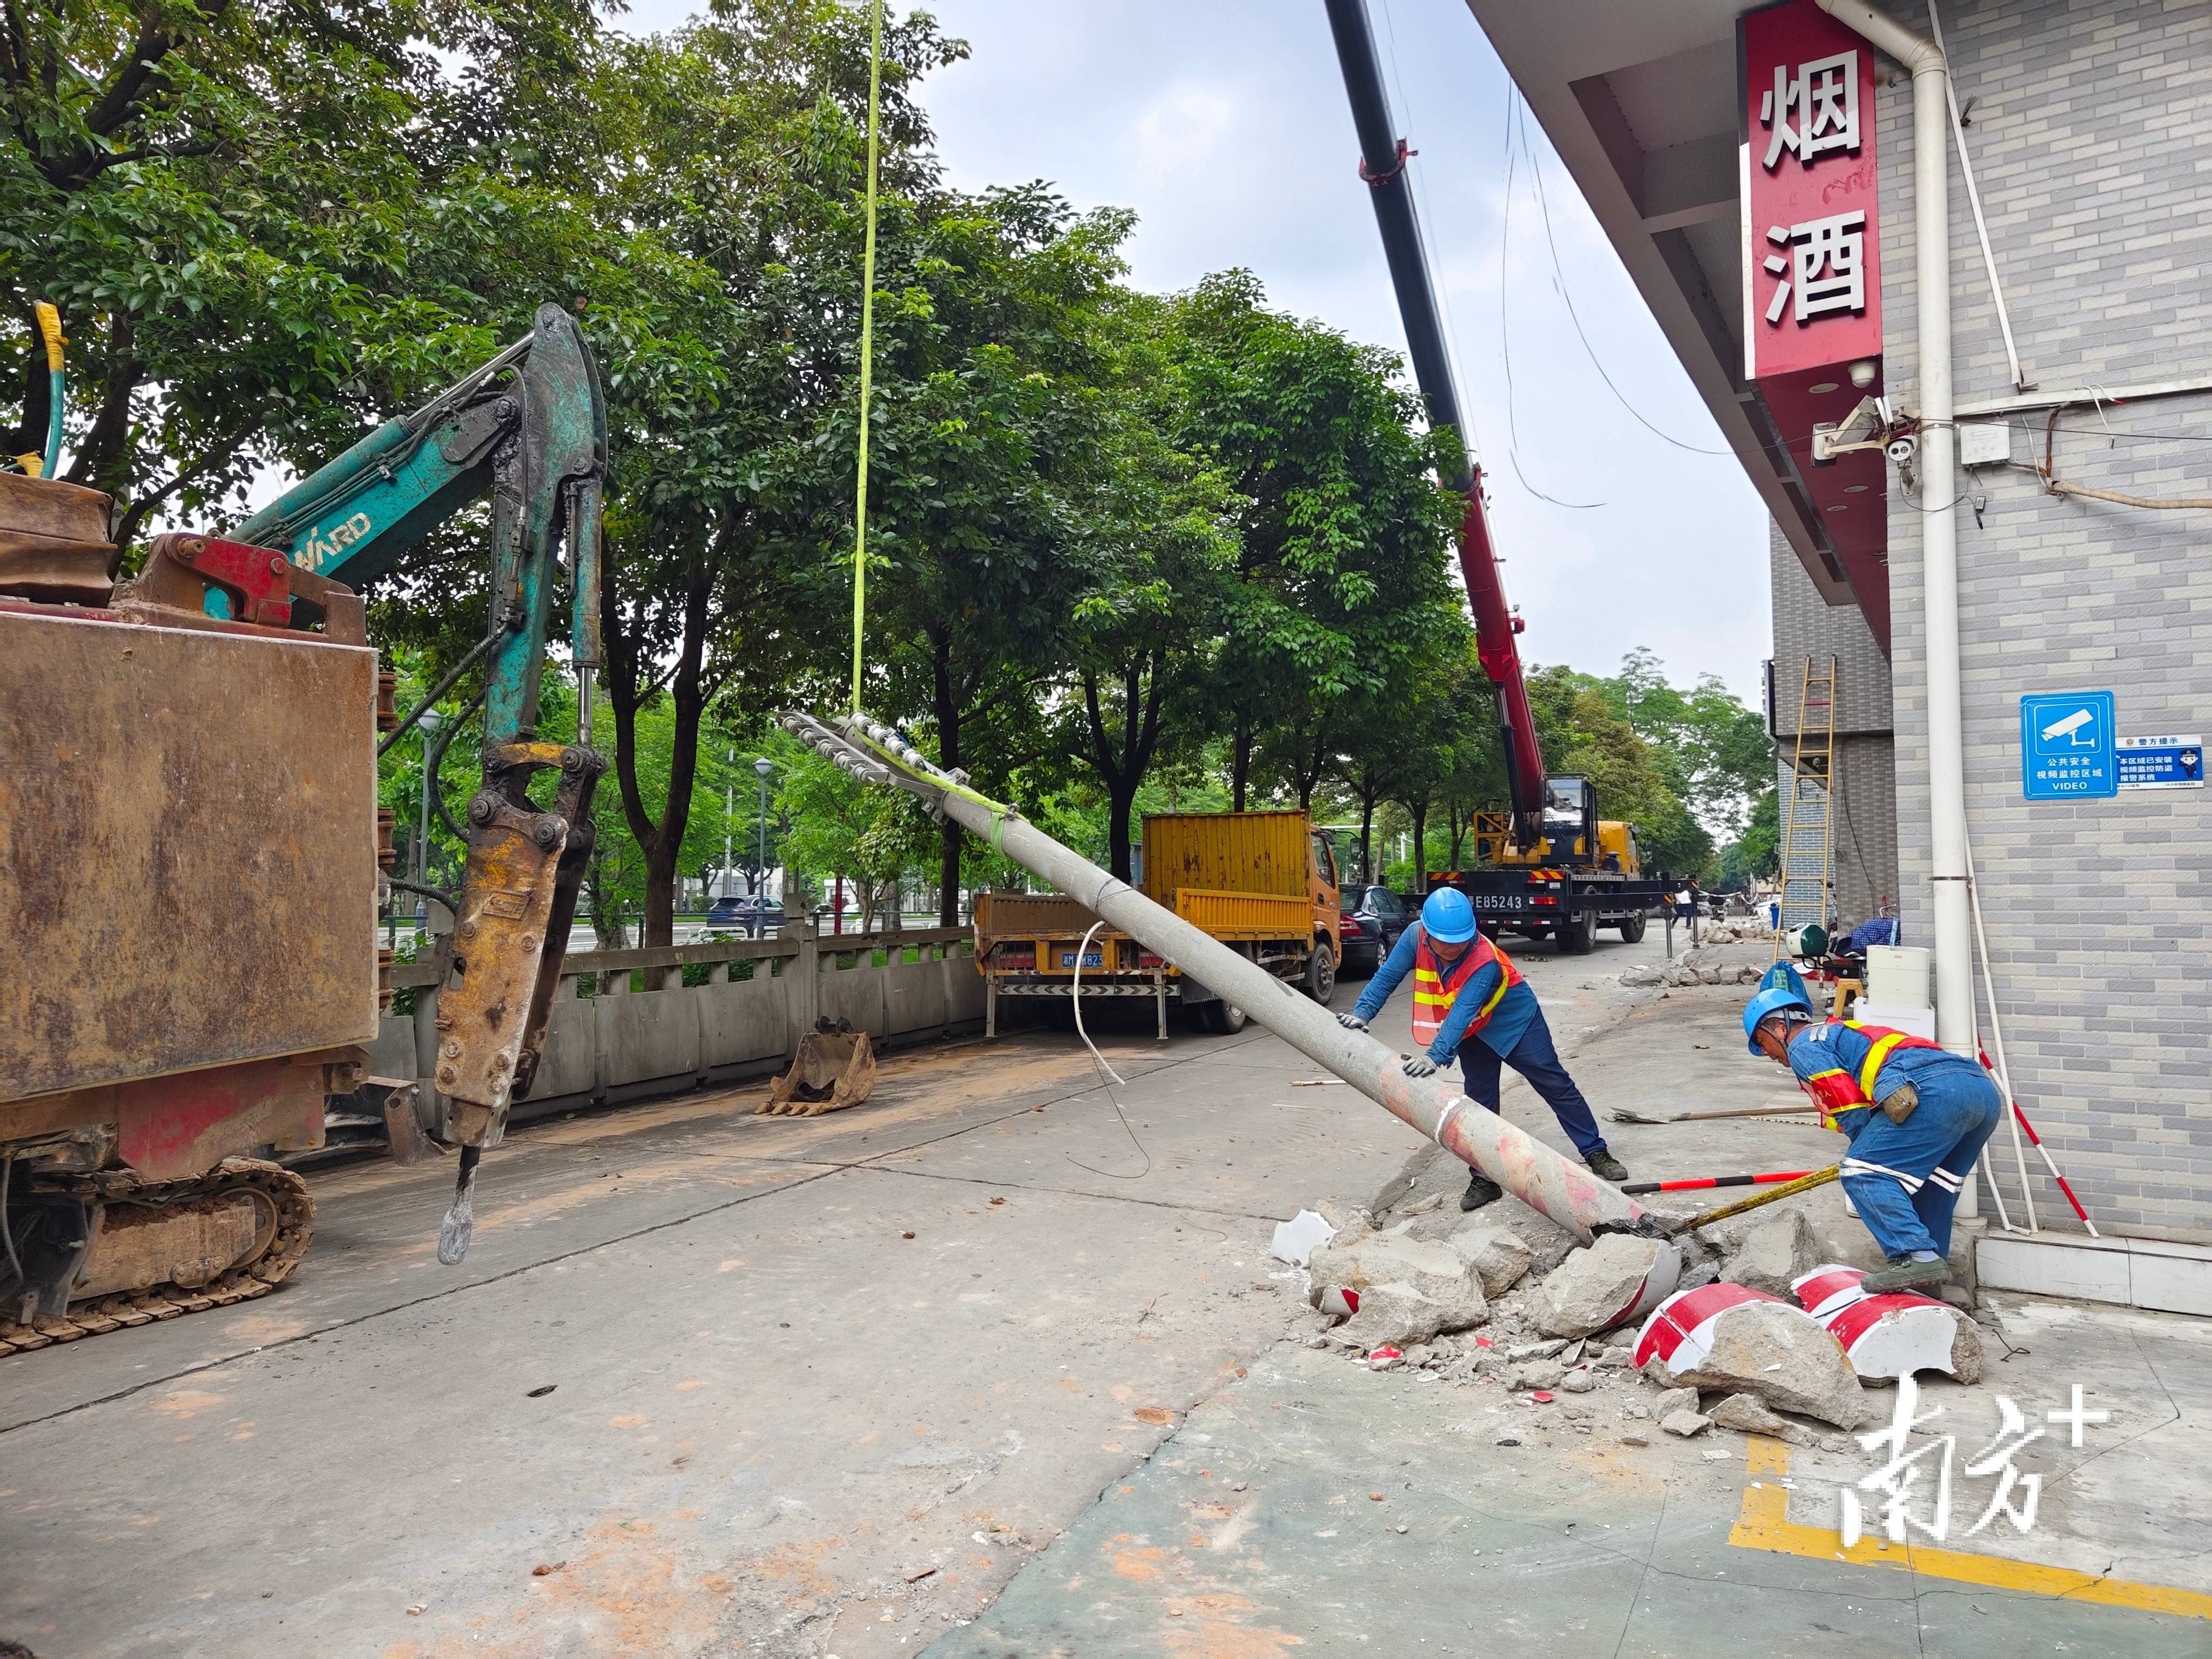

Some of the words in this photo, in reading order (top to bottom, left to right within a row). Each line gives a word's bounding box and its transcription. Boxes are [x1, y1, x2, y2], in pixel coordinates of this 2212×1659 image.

[1760, 49, 1866, 326] 烟酒
[2139, 737, 2178, 745] 警方提示
[2047, 757, 2090, 766] 公共安全
[2120, 756, 2173, 765] 本区域已安装
[2036, 768, 2102, 779] 视频监控区域
[2120, 765, 2173, 773] 视频监控防盗
[2120, 773, 2155, 781] 报警系统
[2052, 781, 2087, 790] VIDEO
